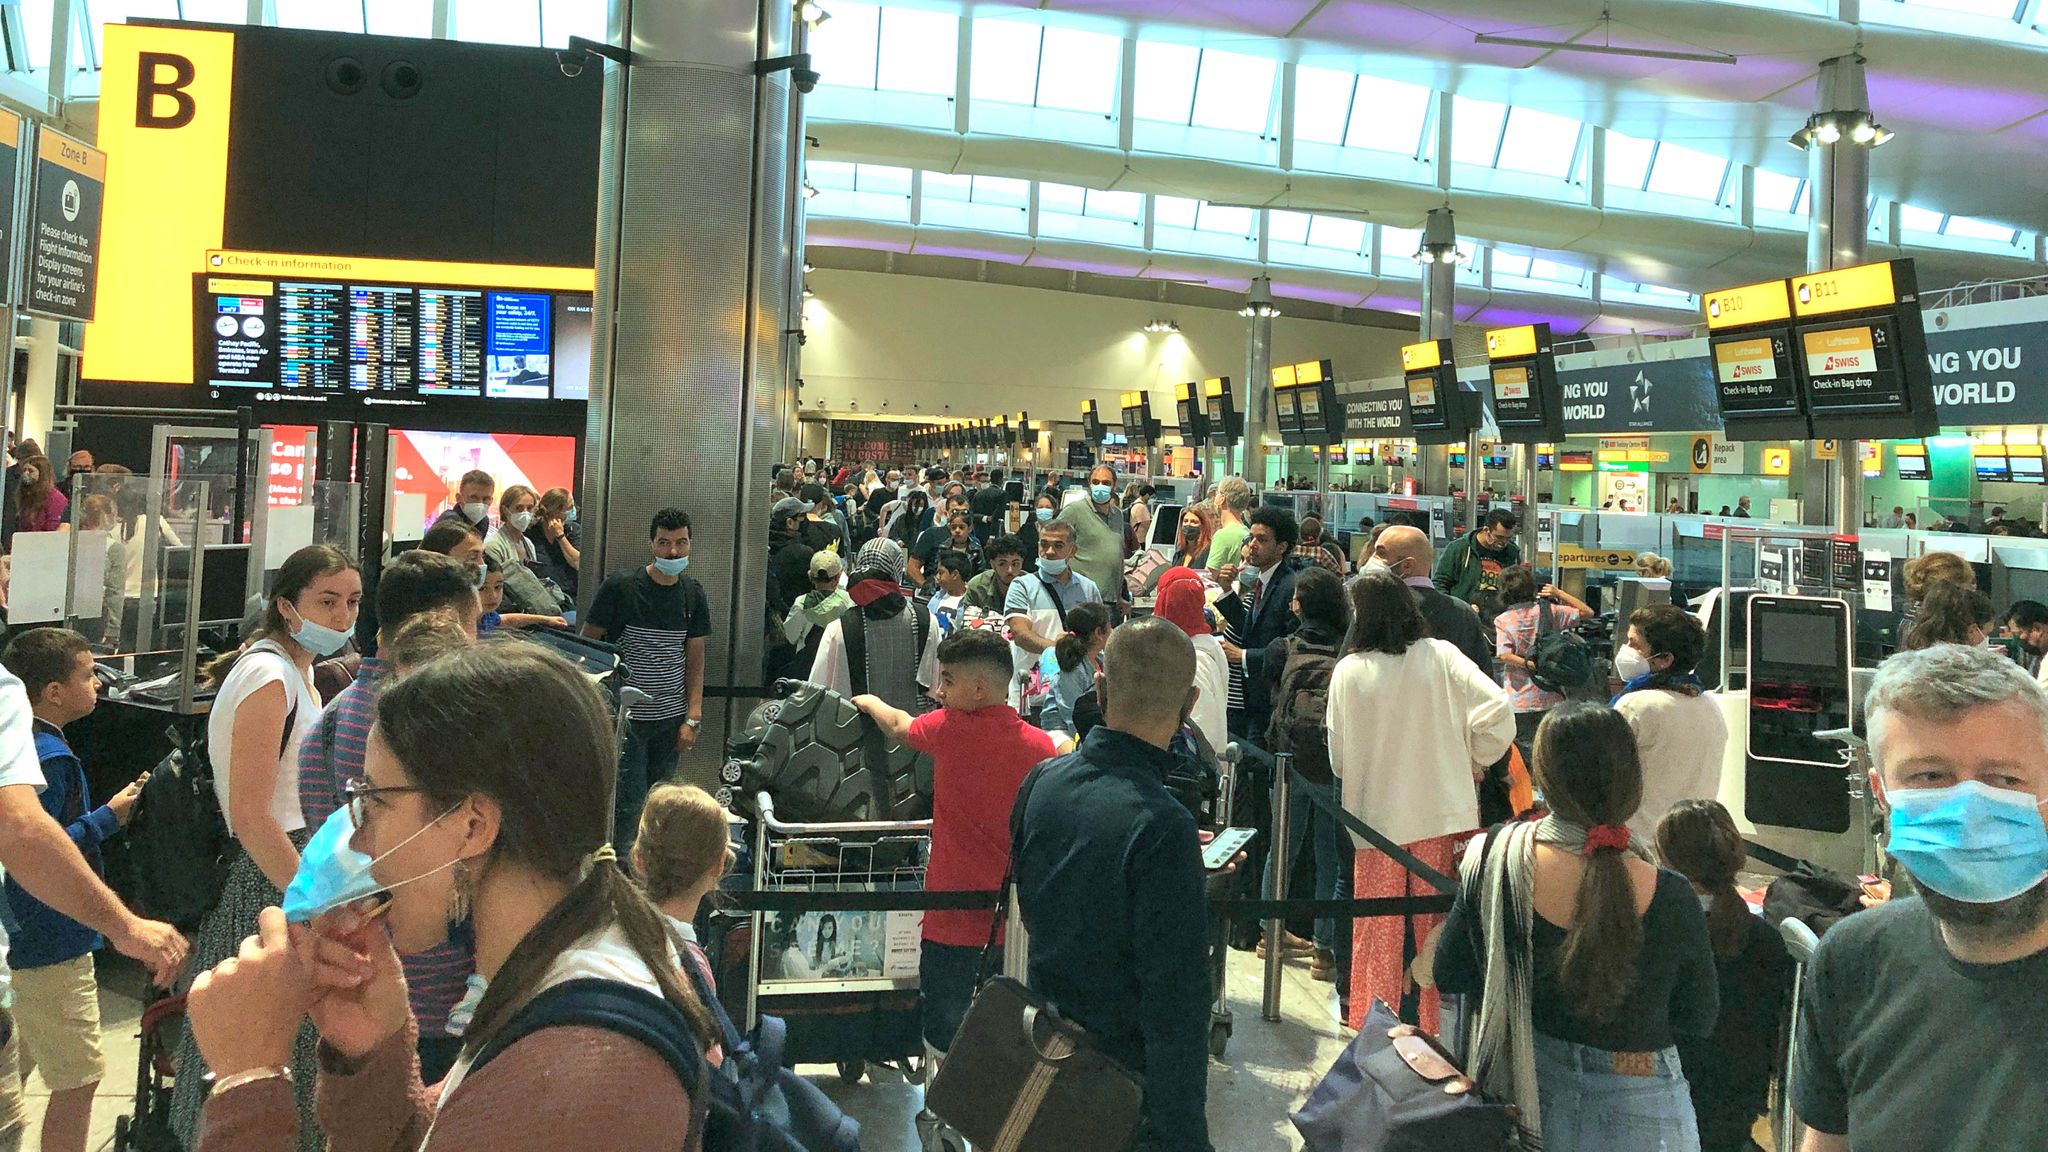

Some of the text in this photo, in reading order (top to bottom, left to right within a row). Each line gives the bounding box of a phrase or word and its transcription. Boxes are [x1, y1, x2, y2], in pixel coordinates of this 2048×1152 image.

[135, 51, 196, 129] B
[61, 142, 88, 166] Zone B
[40, 222, 88, 248] Please check the
[39, 238, 92, 264] Flight Information
[38, 255, 83, 277] Display screens
[227, 255, 352, 271] Check-in information
[37, 270, 86, 293] for your airline's
[1815, 280, 1839, 298] B11
[35, 288, 77, 306] check-in zone
[1723, 296, 1743, 312] B10
[1826, 336, 1860, 347] Lufthansa
[1834, 356, 1860, 368] SWISS
[1966, 346, 2021, 371] YOU
[1741, 365, 1763, 376] SWISS
[1583, 381, 1608, 397] YOU
[1723, 383, 1773, 396] Check-in Bag drop
[1813, 376, 1873, 390] Check-in Bag drop
[1346, 399, 1403, 414] CONNECTING YOU
[1563, 404, 1605, 420] WORLD
[1347, 416, 1401, 429] WITH THE WORLD
[844, 440, 890, 450] WELCOME
[1714, 443, 1735, 453] Repack
[843, 450, 889, 460] TO COSTA
[1713, 456, 1727, 464] area
[270, 462, 293, 475] so
[1550, 553, 1606, 564] epartures
